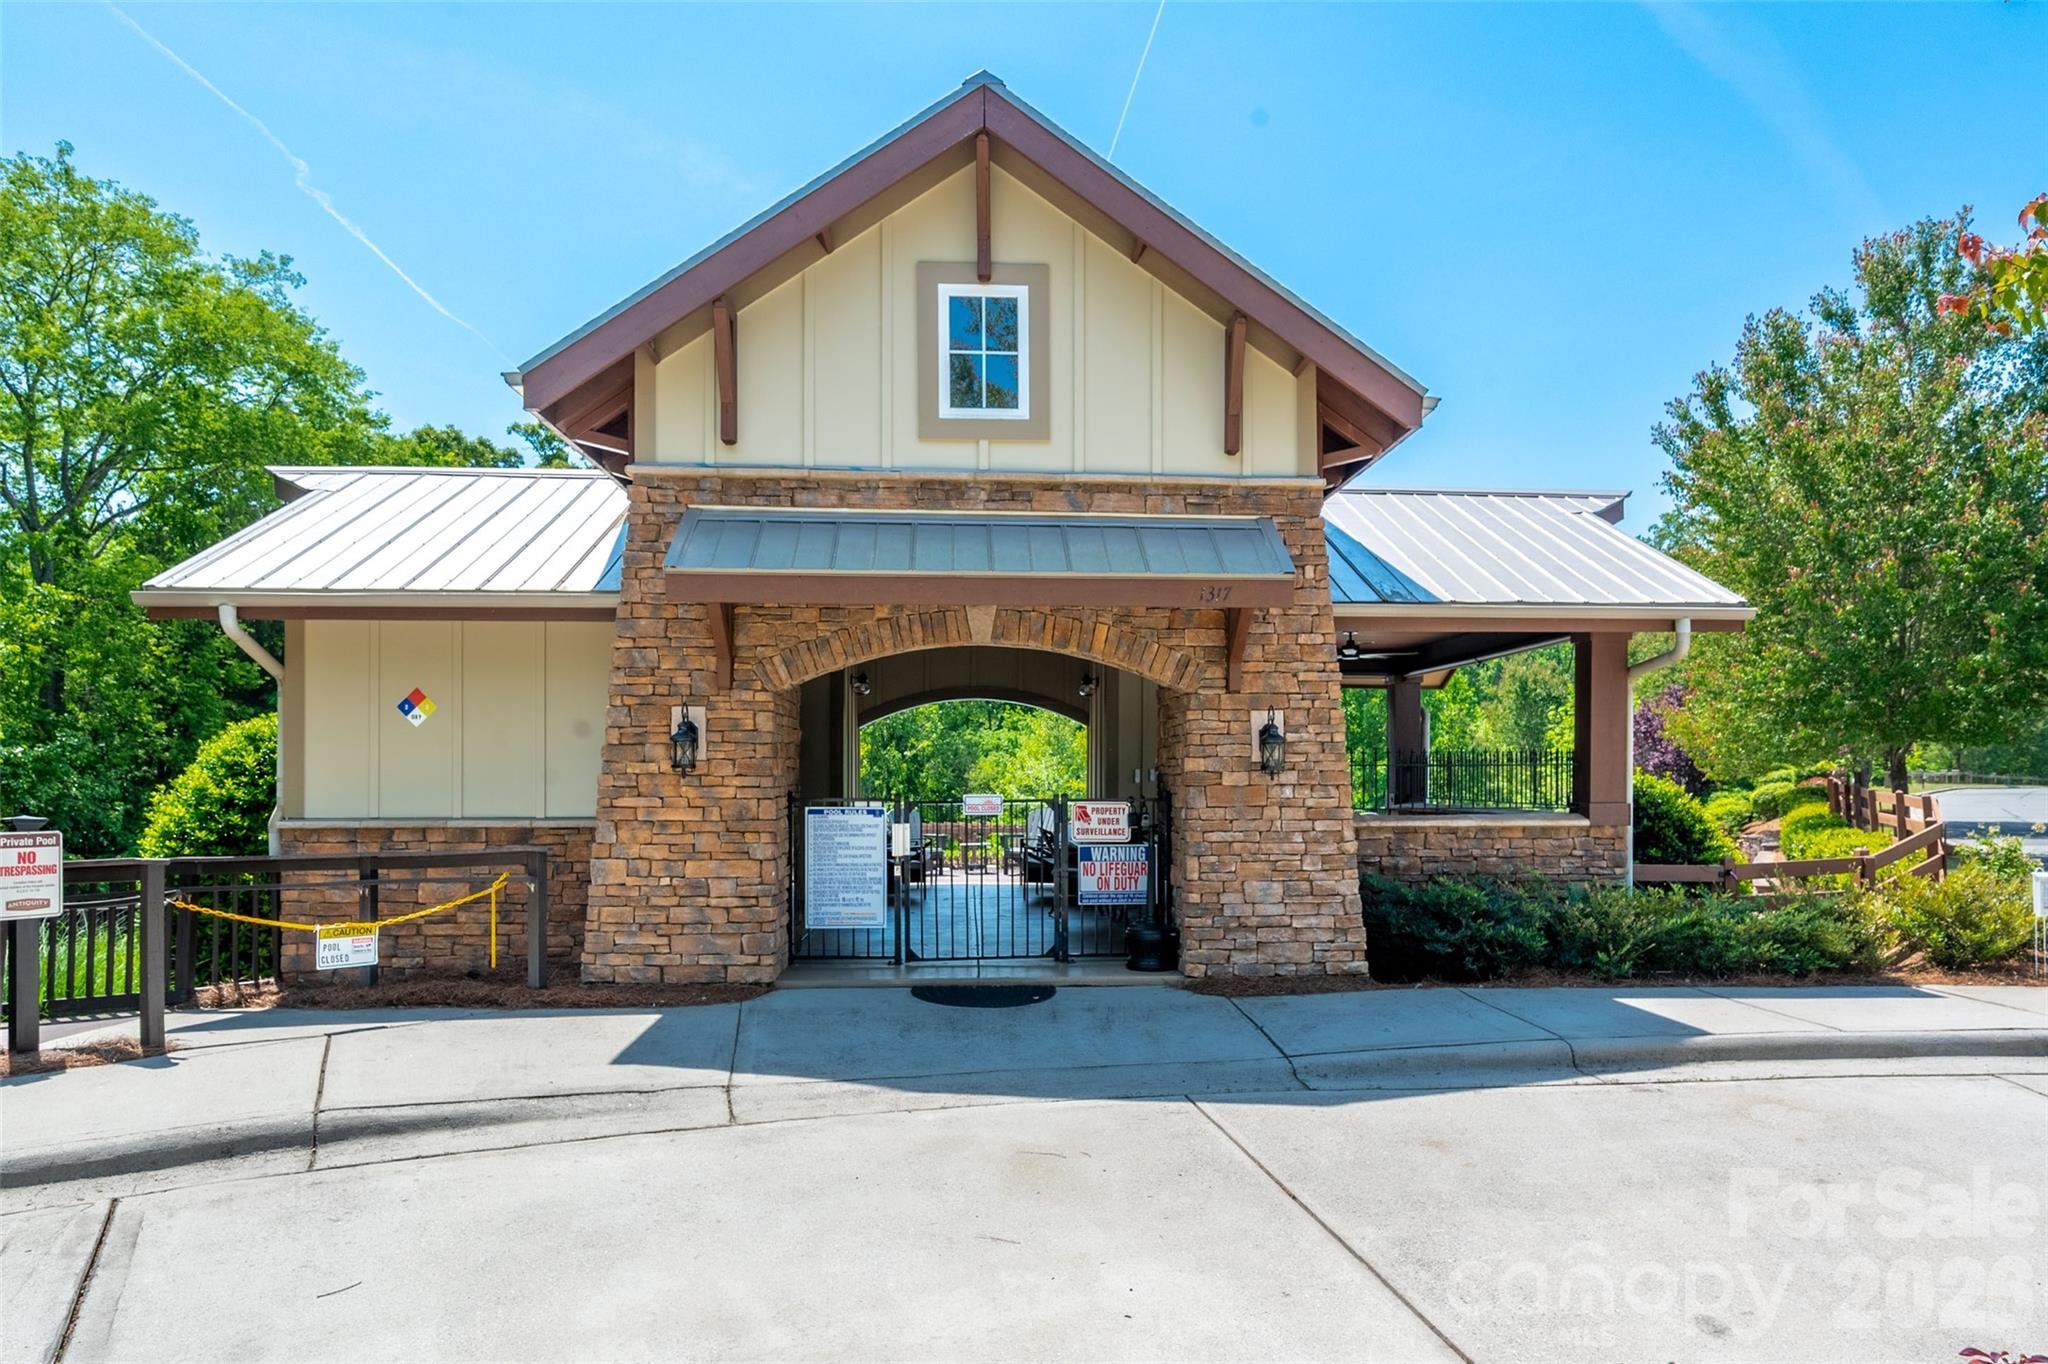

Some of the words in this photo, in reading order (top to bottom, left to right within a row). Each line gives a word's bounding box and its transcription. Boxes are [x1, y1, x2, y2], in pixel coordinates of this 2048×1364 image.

[1200, 585, 1232, 602] 1317
[1091, 807, 1126, 815] PROPERTY
[1097, 817, 1120, 826] UNDER
[1076, 828, 1126, 836] SURVEILLANCE
[1, 838, 33, 846] Private
[36, 836, 56, 845] Pool
[18, 851, 36, 864] NO
[1090, 847, 1146, 861] WARNING
[0, 864, 57, 876] TRESPASSING
[1083, 863, 1096, 876] NO
[1100, 863, 1147, 876] LIFEGUAR
[1097, 877, 1110, 891] ON
[1114, 877, 1139, 890] DUTY
[7, 900, 49, 908] ANTIQUITY
[333, 927, 372, 936] CAUTION
[321, 954, 349, 964] CLOSED
